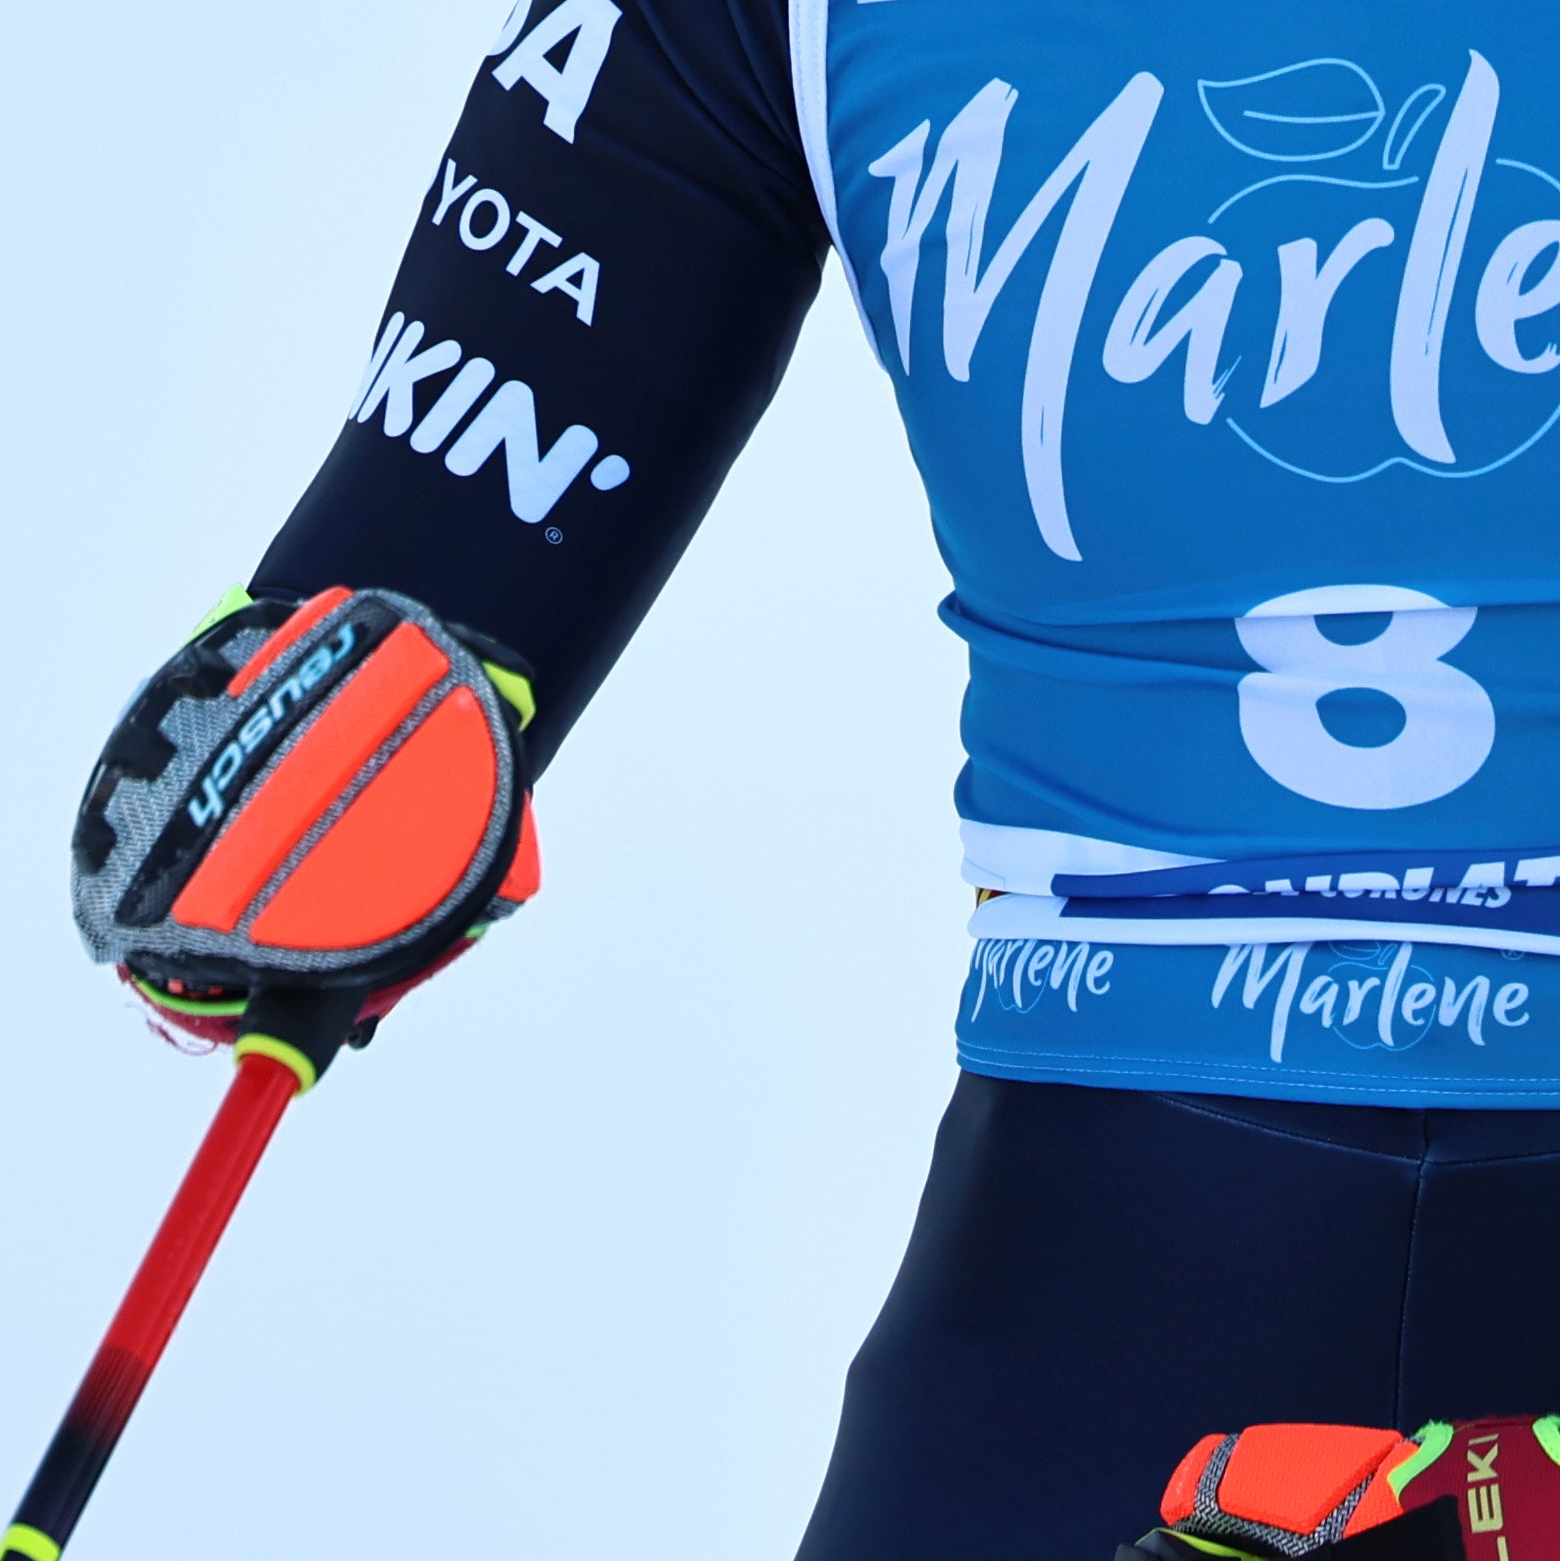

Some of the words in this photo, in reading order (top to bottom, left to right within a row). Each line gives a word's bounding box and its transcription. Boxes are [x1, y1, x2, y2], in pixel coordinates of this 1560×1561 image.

[431, 158, 601, 327] YOTA
[188, 622, 356, 827] reusch
[1235, 583, 1496, 809] 8
[1212, 942, 1530, 1063] Marlene
